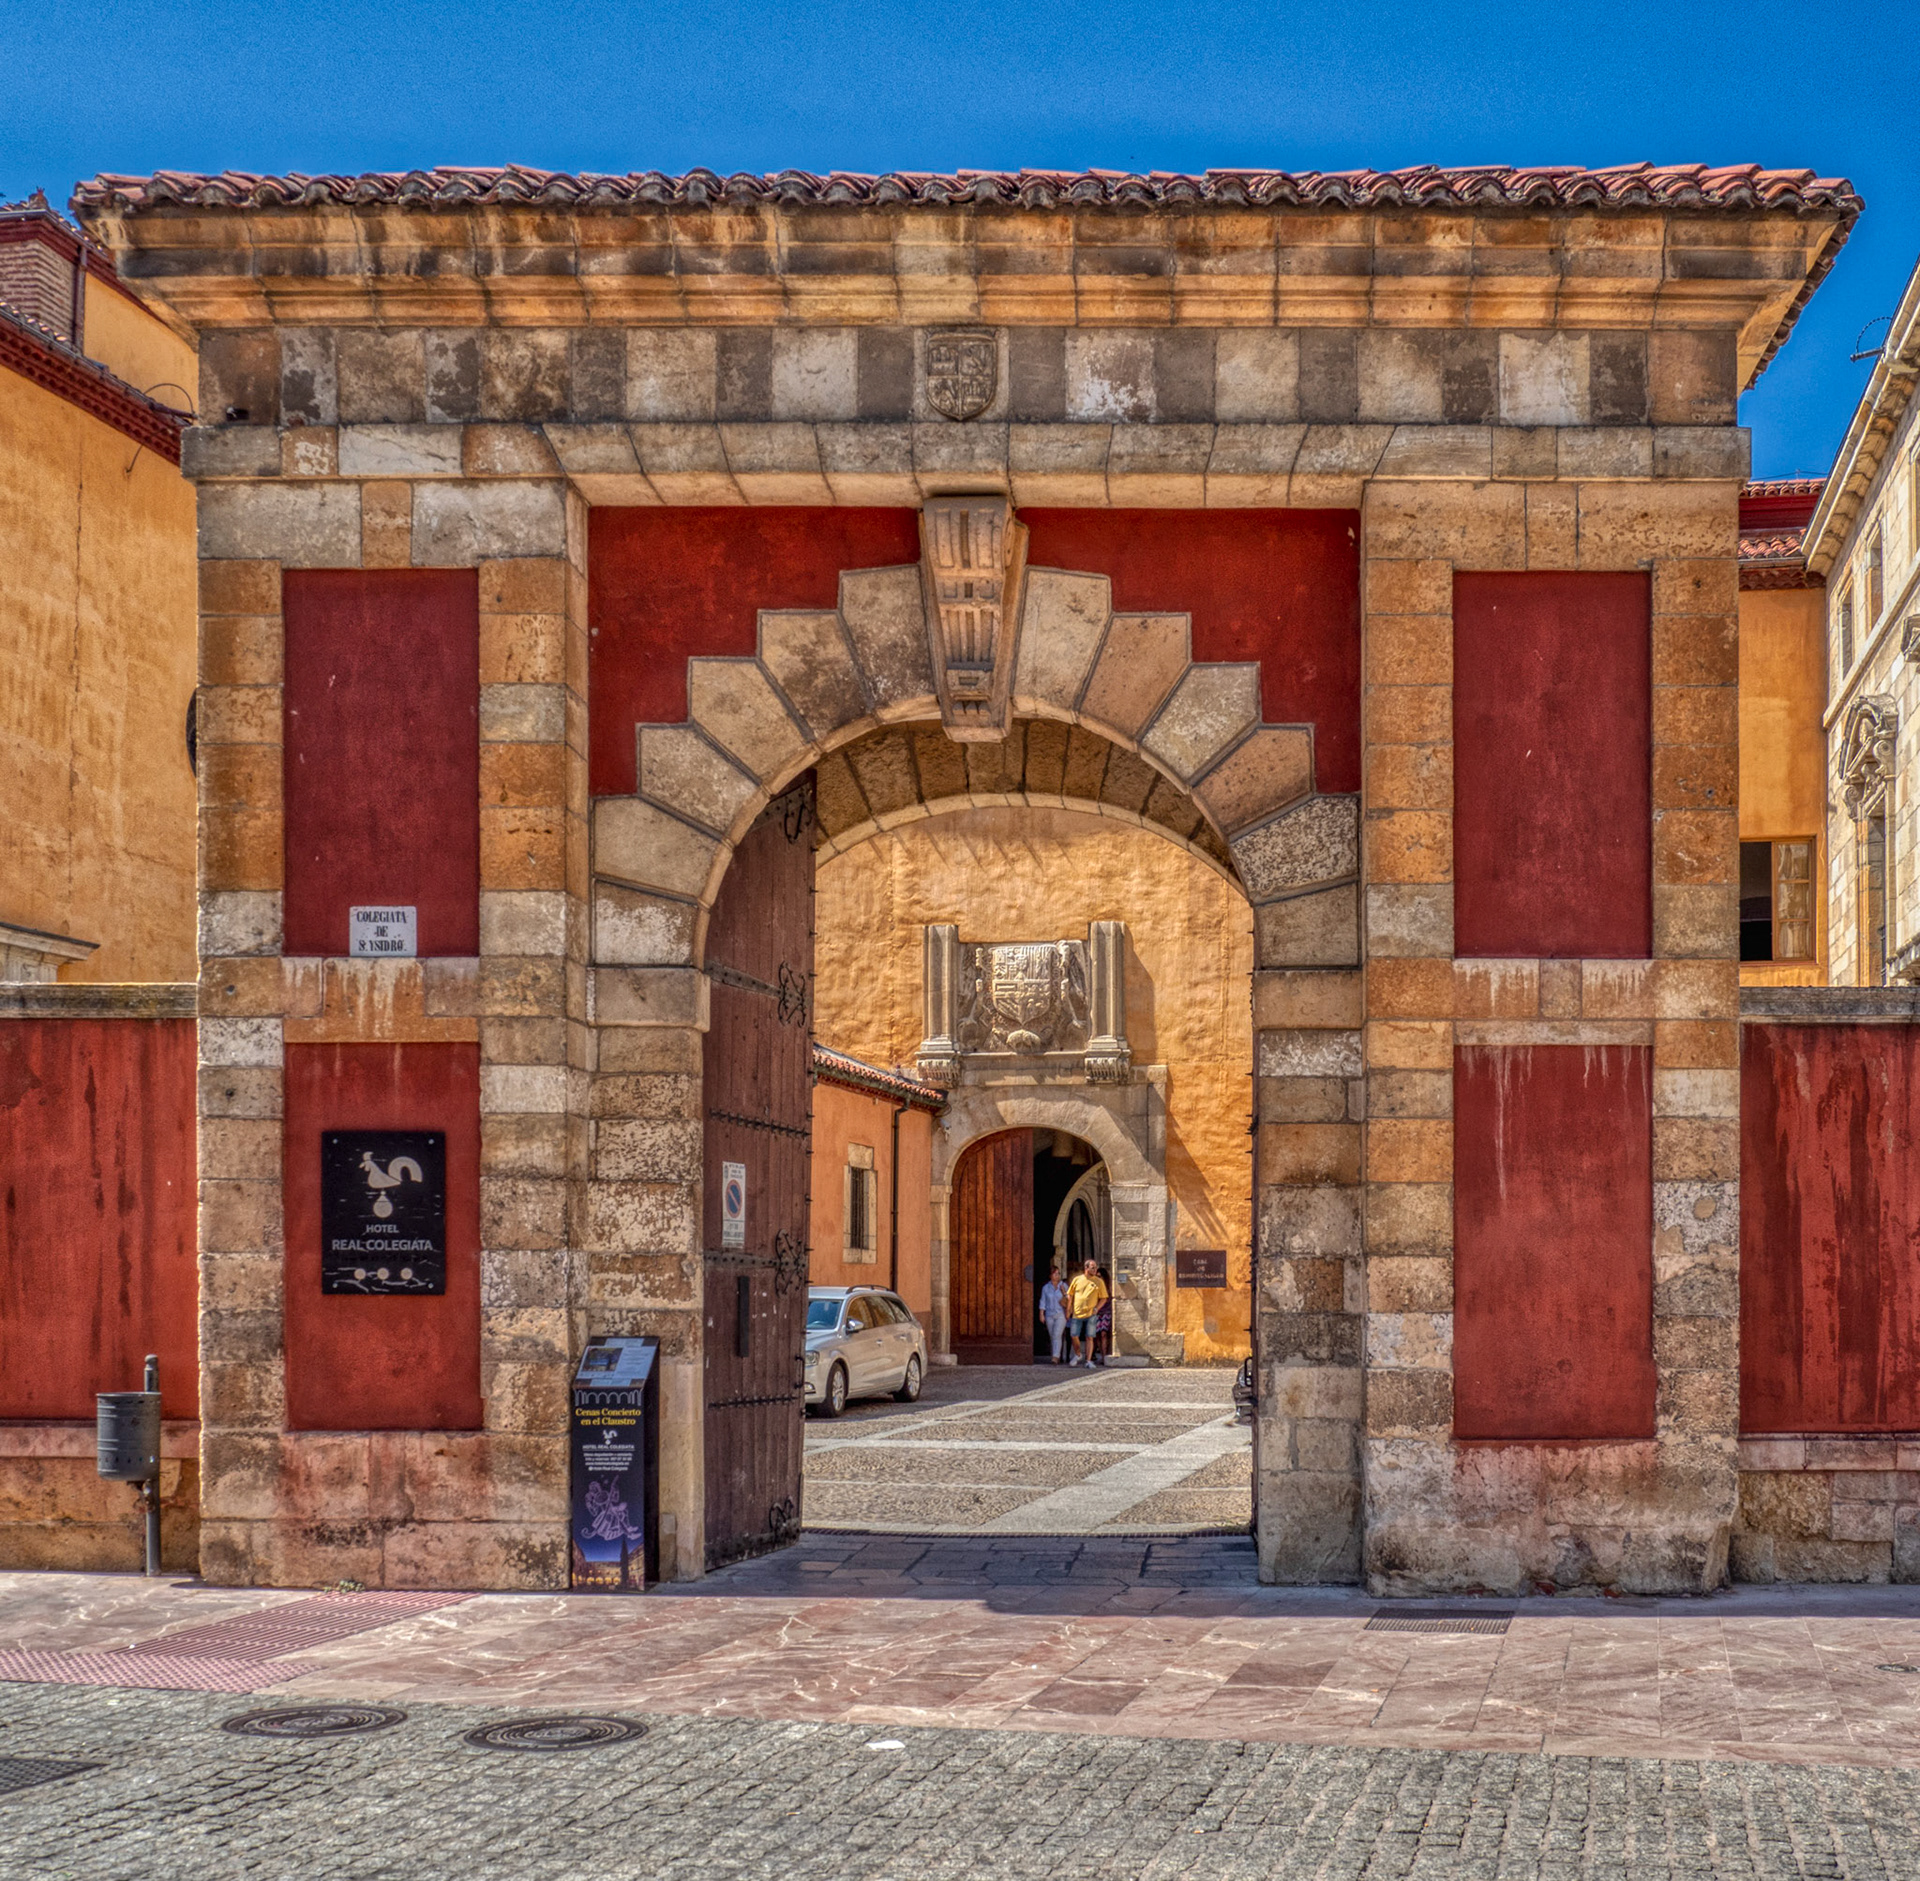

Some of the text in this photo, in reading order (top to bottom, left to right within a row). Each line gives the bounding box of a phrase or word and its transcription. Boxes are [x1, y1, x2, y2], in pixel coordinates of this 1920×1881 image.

[356, 911, 406, 923] COLEGIATA
[376, 926, 388, 937] DE
[366, 1224, 399, 1233] HOTEL
[332, 1240, 433, 1250] REAL COLEGIATA
[575, 1408, 642, 1416] Cenas Concierto
[592, 1418, 600, 1426] el
[601, 1417, 636, 1426] Claustro
